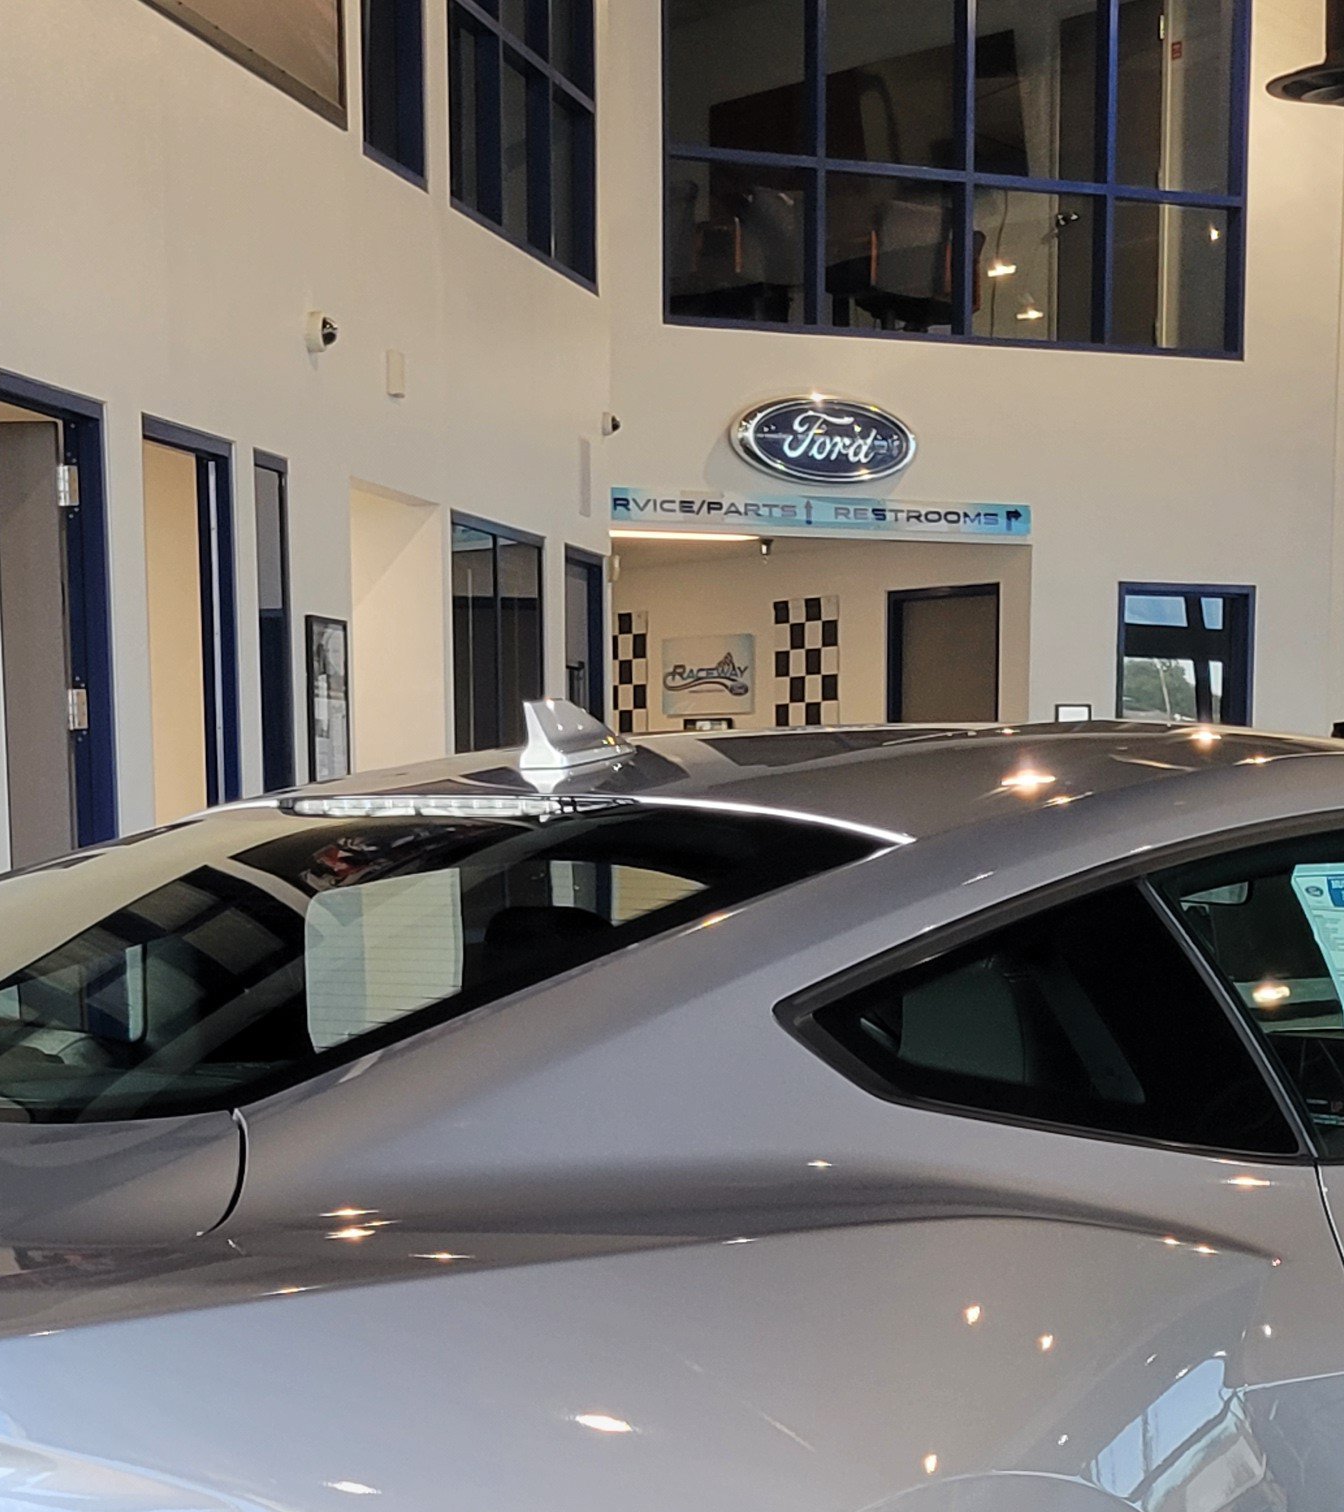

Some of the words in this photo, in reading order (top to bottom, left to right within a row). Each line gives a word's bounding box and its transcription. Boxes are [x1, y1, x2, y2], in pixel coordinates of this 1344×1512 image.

[782, 411, 875, 464] Ford
[834, 507, 998, 526] RESTROOMS
[665, 663, 748, 681] RACEWAY
